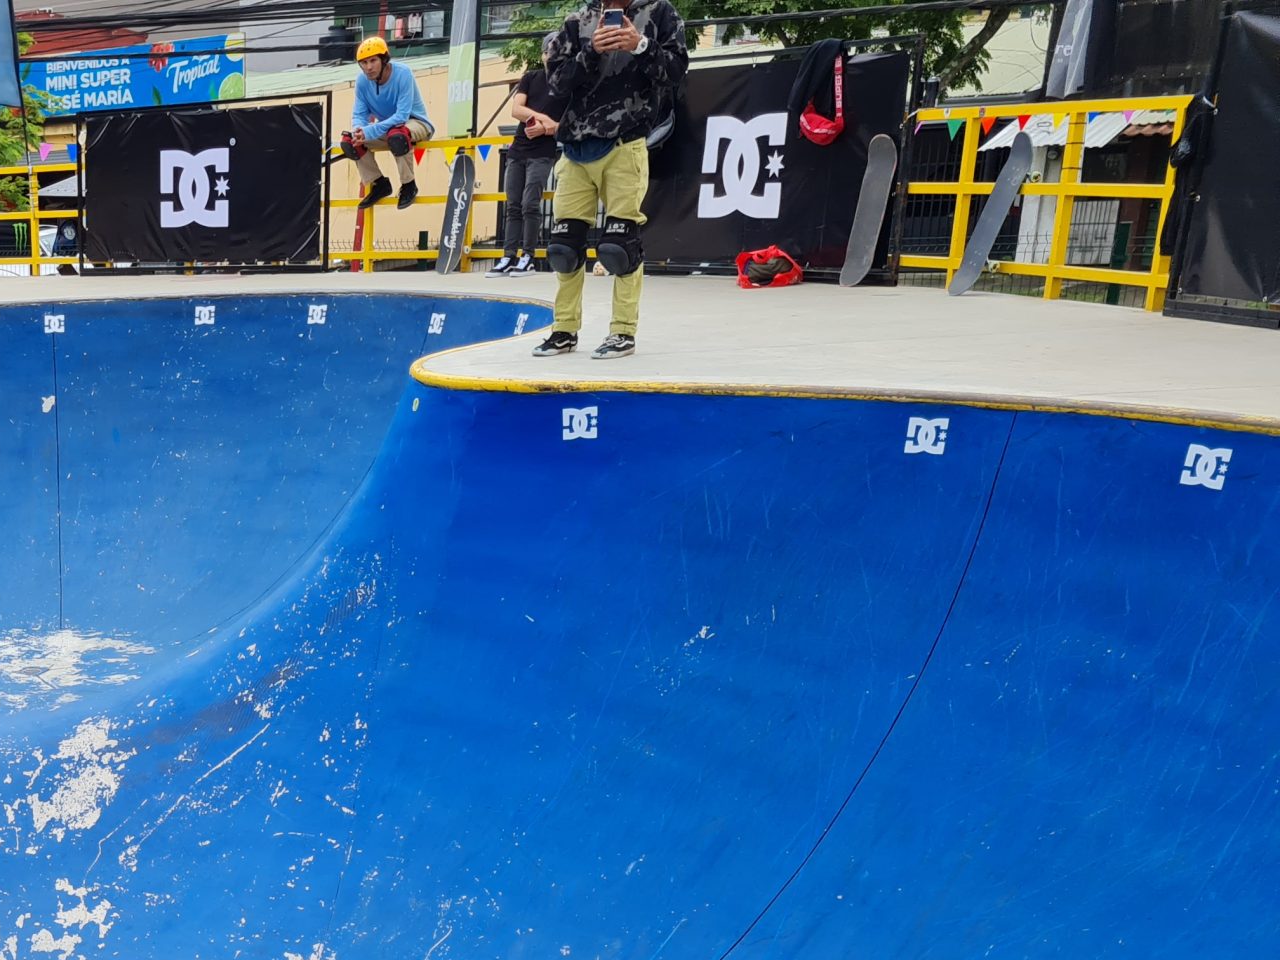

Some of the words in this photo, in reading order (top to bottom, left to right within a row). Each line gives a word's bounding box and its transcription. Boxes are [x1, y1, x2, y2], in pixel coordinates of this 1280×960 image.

[46, 74, 77, 91] MINI
[80, 69, 131, 88] SUPER
[166, 54, 220, 94] Tropical
[84, 86, 134, 107] MARÍA
[698, 113, 787, 219] DC
[160, 148, 230, 228] DC
[563, 406, 598, 440] DC
[904, 417, 949, 455] DC
[1180, 444, 1233, 490] DC
